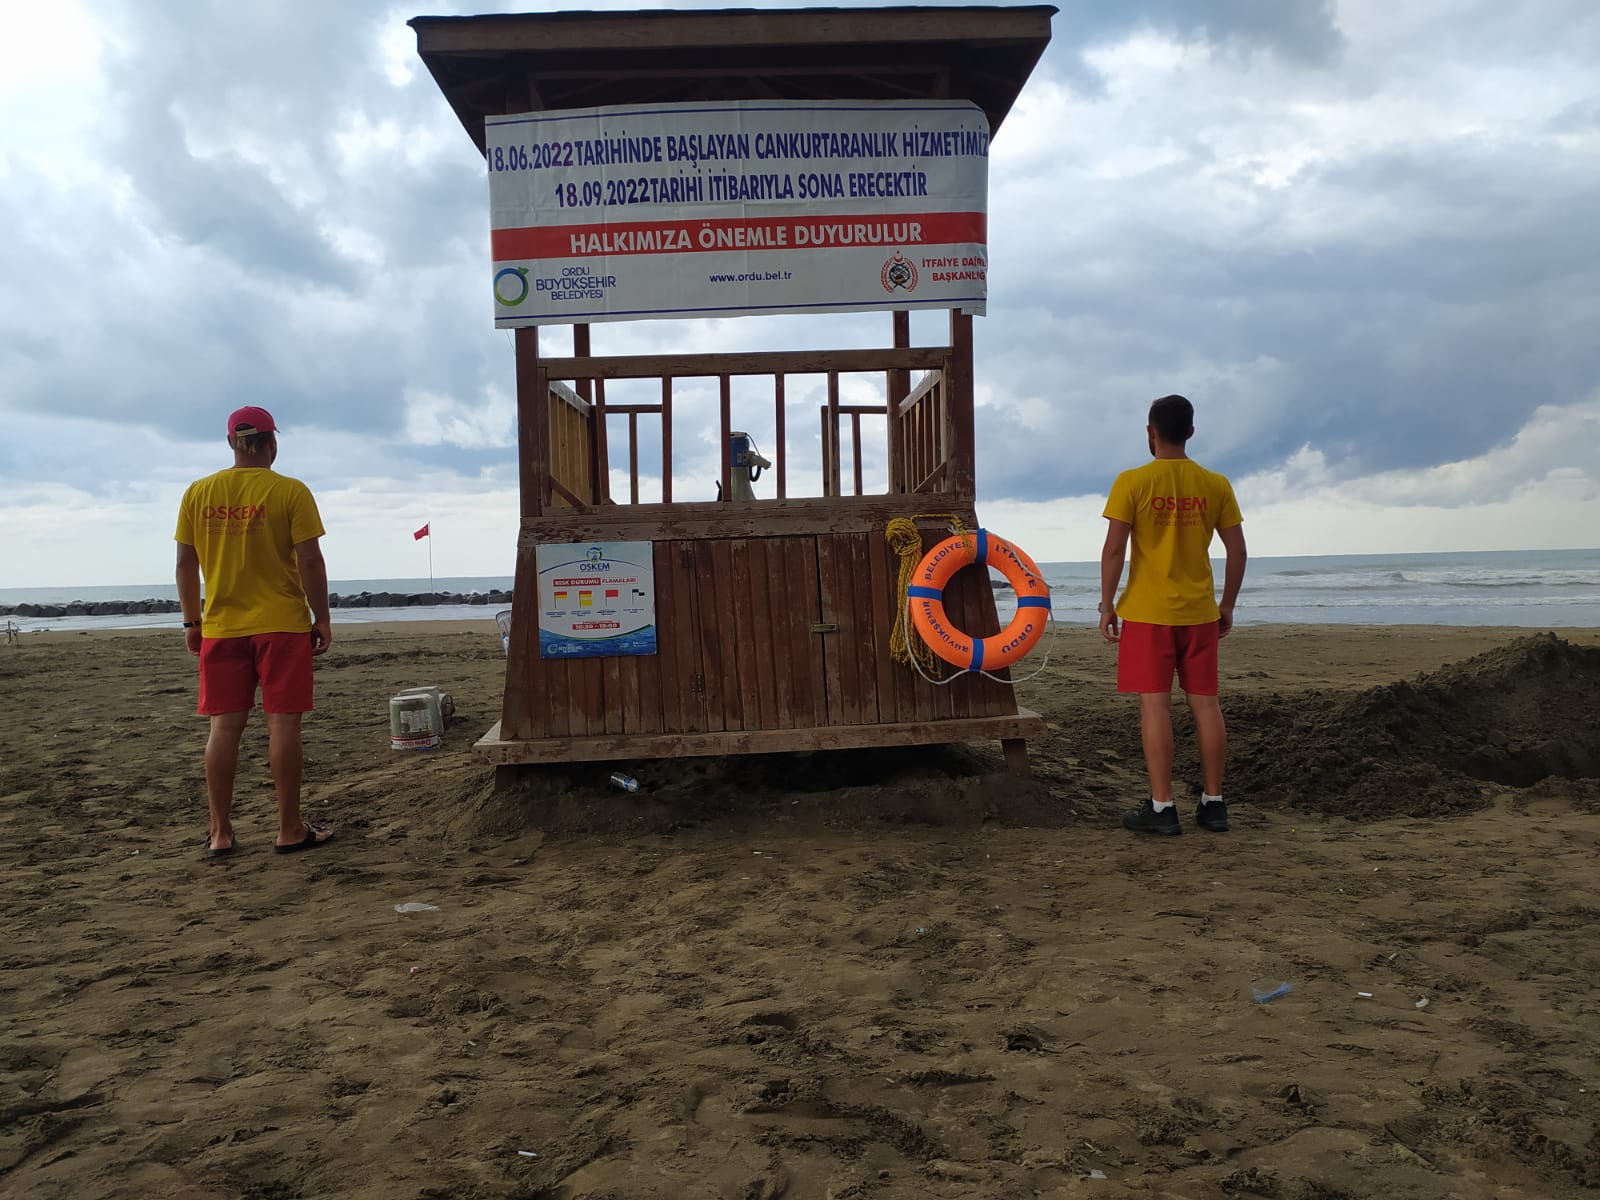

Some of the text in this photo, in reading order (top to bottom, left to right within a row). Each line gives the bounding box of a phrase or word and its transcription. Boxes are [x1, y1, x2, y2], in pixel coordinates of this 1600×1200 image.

[667, 134, 749, 168] BAŞLAYAN
[755, 132, 898, 159] CANKURTARANLIK
[903, 124, 988, 158] HİZMETİMİZ
[708, 168, 794, 201] İTİBARIYLA
[798, 173, 845, 199] SONA
[849, 165, 928, 197] ERECEKTİR
[570, 222, 922, 254] HALKIMIZA ÖNEMLE DUYURULUR
[922, 256, 959, 268] İTFAİYE
[562, 267, 590, 276] ORDU
[709, 271, 793, 283] www.ordu.bel.tr
[202, 503, 266, 521] OSKEM
[580, 562, 611, 571] OSKEM
[1001, 623, 1033, 655] ORDU
